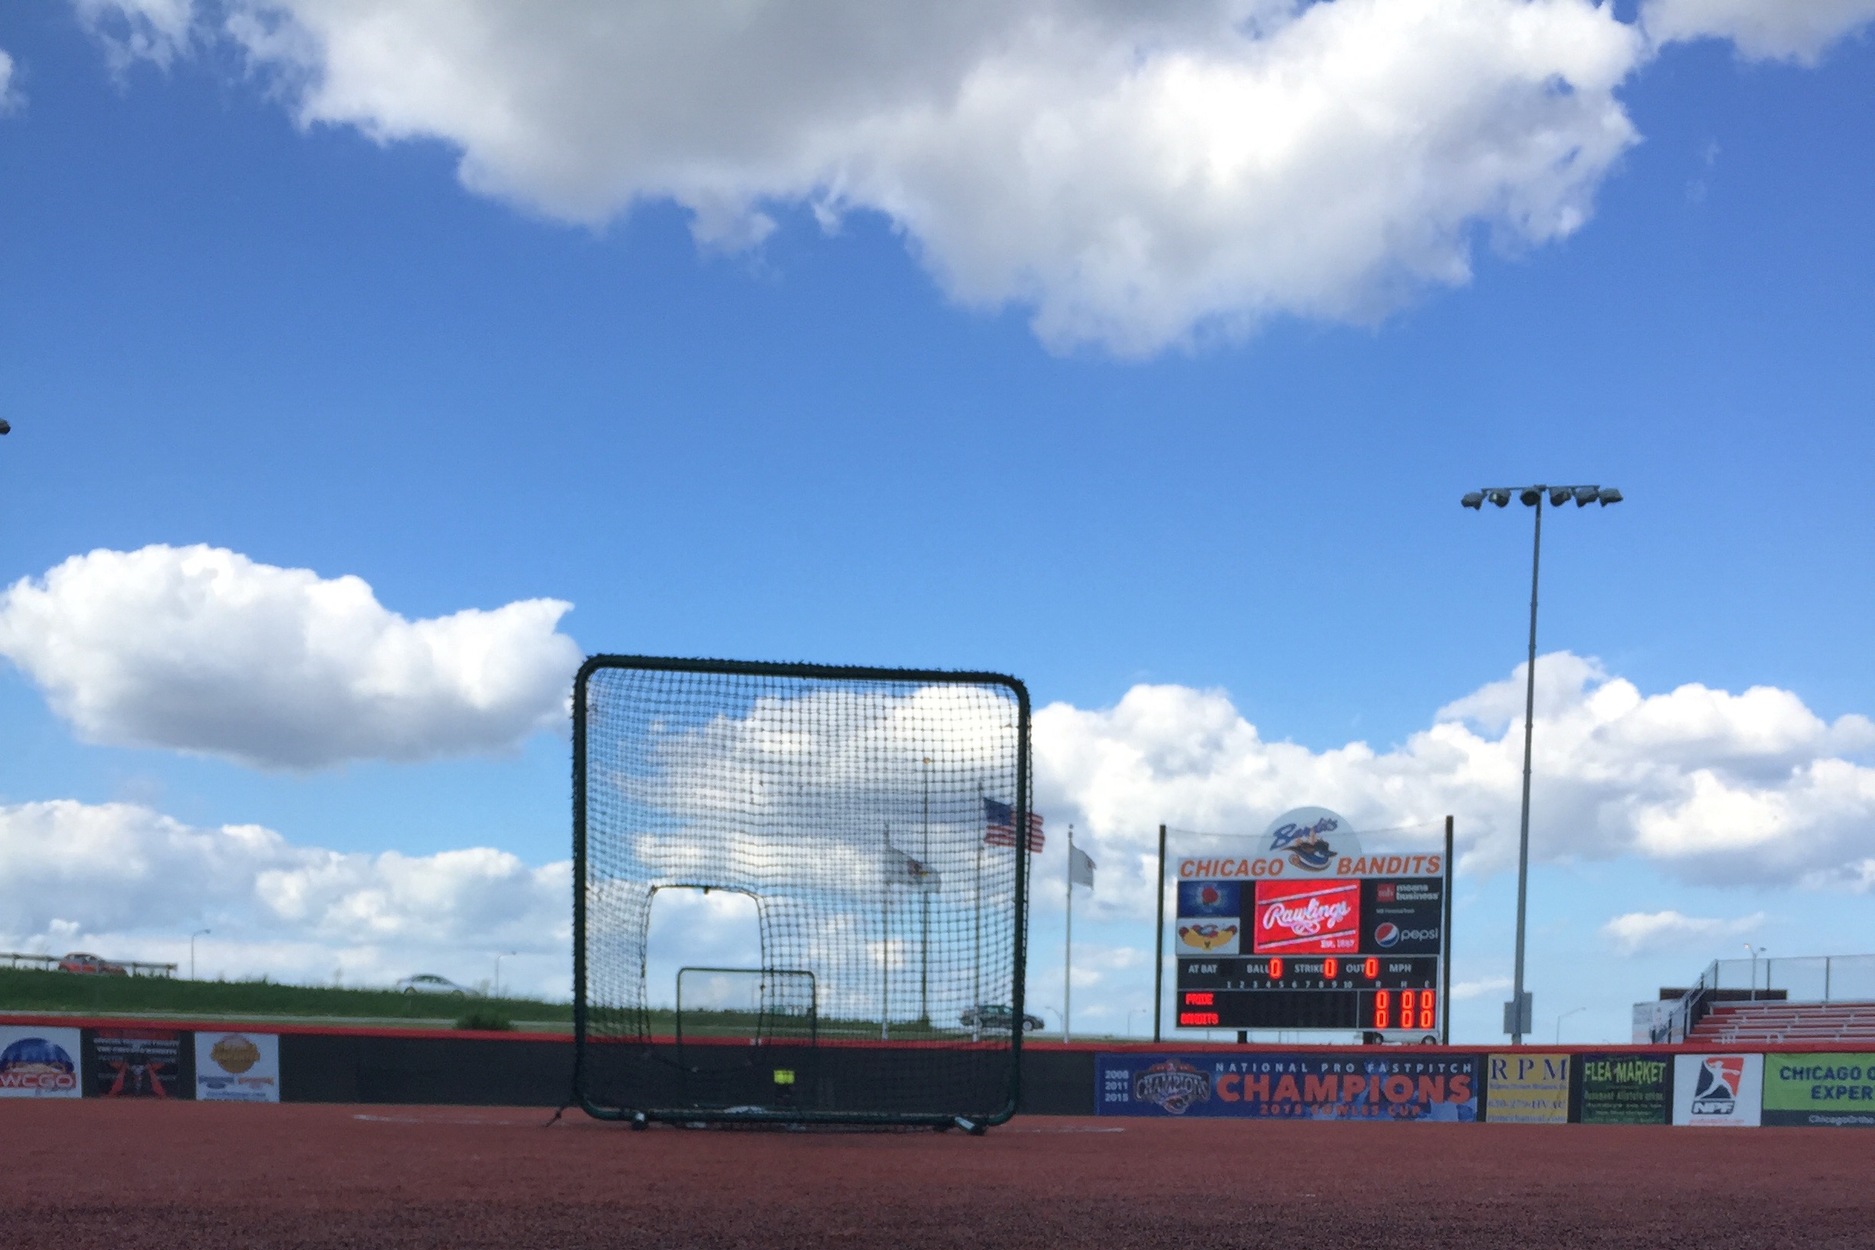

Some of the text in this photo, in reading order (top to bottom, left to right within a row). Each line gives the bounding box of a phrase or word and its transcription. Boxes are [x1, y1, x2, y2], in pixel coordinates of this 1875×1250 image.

[1180, 855, 1442, 878] CHICAGO BANDITS
[1263, 898, 1351, 930] Rawlings
[1401, 928, 1439, 941] pepsi
[1188, 964, 1218, 974] AT BAT
[1269, 957, 1283, 979] 0
[1324, 957, 1338, 979] 0
[1365, 956, 1379, 979] 0
[1389, 964, 1412, 973] MPH
[1375, 990, 1389, 1010] 0
[1401, 990, 1415, 1010] 0
[1421, 990, 1434, 1010] 0
[1375, 1009, 1388, 1028] 0
[1401, 1009, 1414, 1028] 0
[1420, 1009, 1433, 1028] 0
[1216, 1063, 1472, 1073] NATIONAL PRO FASTPITCH
[1491, 1058, 1568, 1080] RPM
[1584, 1061, 1666, 1084] FLEA MARKET
[1780, 1066, 1861, 1080] CHICAGO
[0, 1074, 73, 1088] WCGO
[1105, 1082, 1128, 1090] 2011
[1136, 1072, 1209, 1100] CHAMPIONS
[1216, 1074, 1471, 1103] CHAMPIONS
[1388, 1104, 1421, 1115] CUP
[1694, 1102, 1733, 1114] NPF
